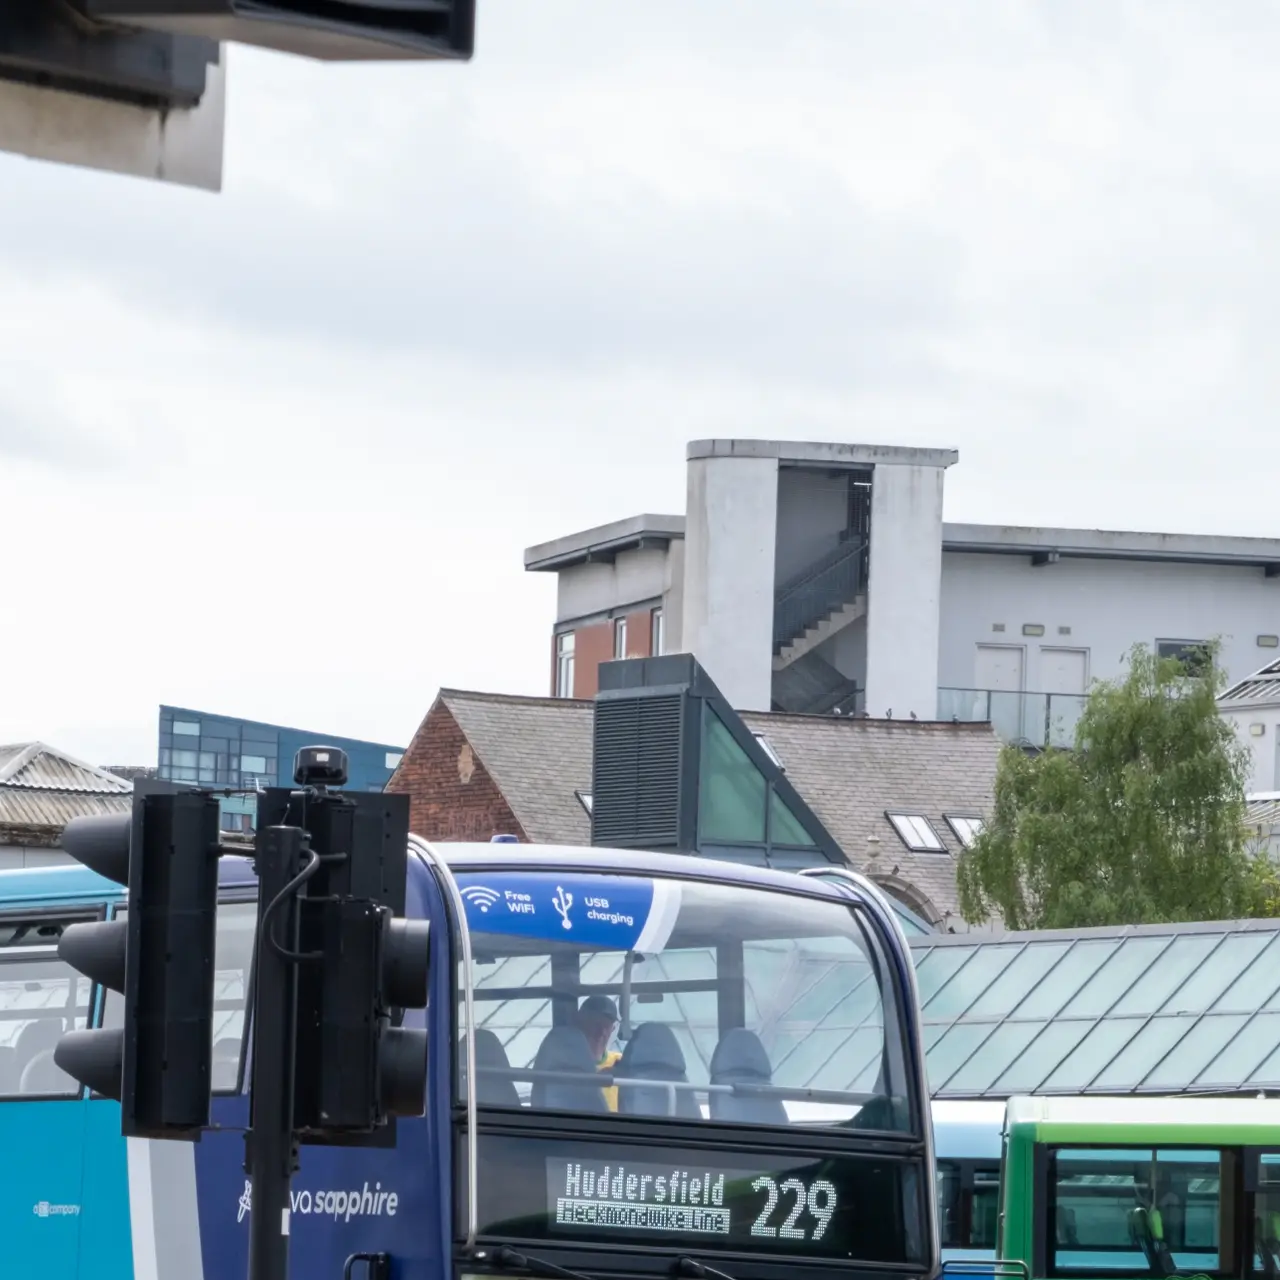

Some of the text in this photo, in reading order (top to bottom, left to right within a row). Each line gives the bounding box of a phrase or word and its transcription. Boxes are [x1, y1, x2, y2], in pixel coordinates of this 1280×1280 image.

[504, 891, 531, 902] Free
[585, 897, 609, 908] USB
[587, 910, 634, 926] charging
[565, 1164, 724, 1206] Huddersfield
[314, 1182, 399, 1223] sapphire
[751, 1177, 837, 1240] 229
